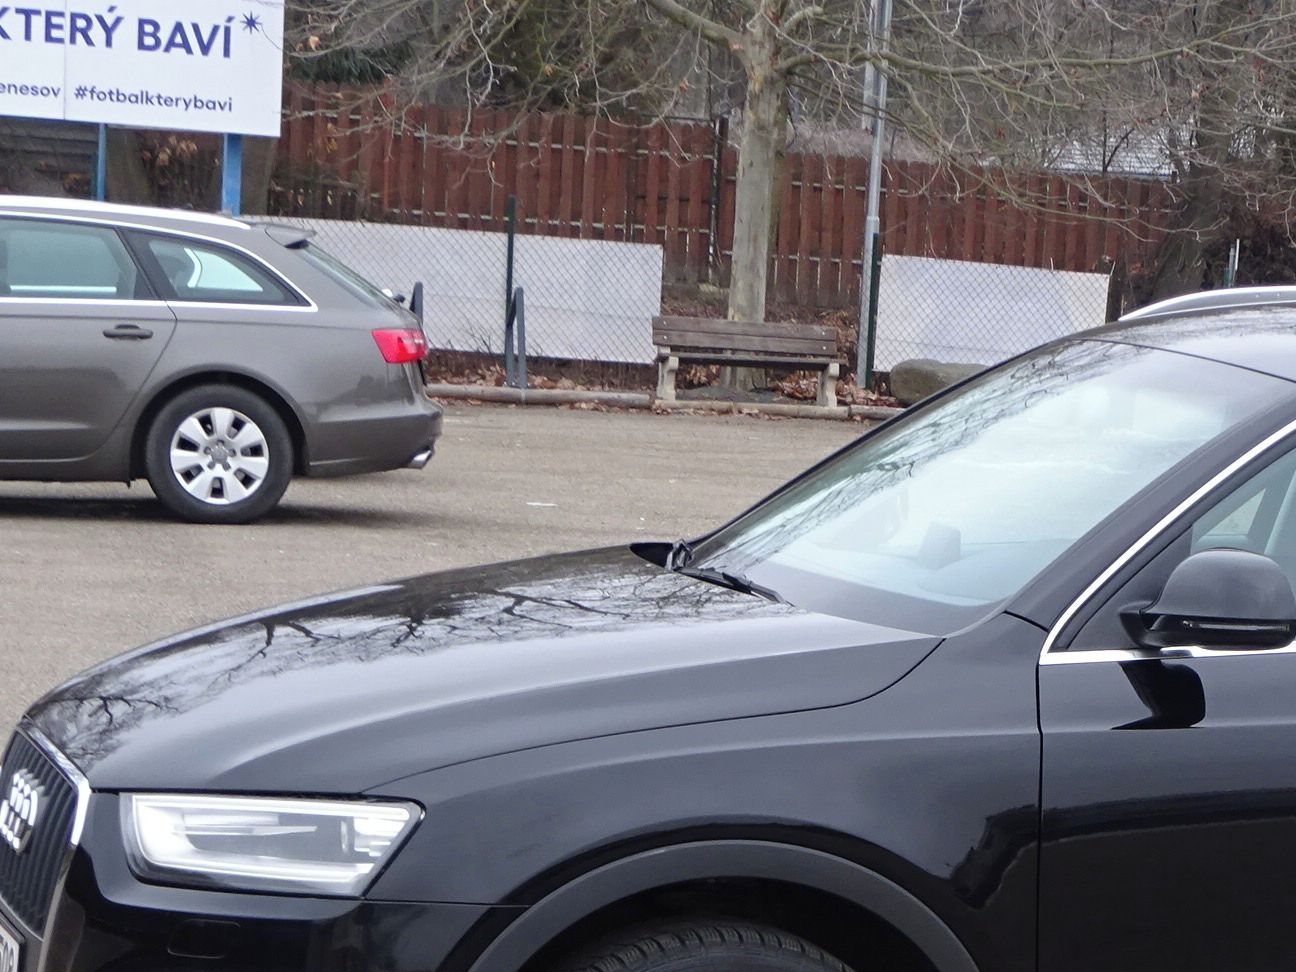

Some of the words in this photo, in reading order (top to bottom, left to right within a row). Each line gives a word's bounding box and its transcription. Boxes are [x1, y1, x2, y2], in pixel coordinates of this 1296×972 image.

[137, 15, 236, 58] BAVÍ
[0, 82, 61, 98] enesov
[74, 85, 233, 112] #fotbalkterybavi
